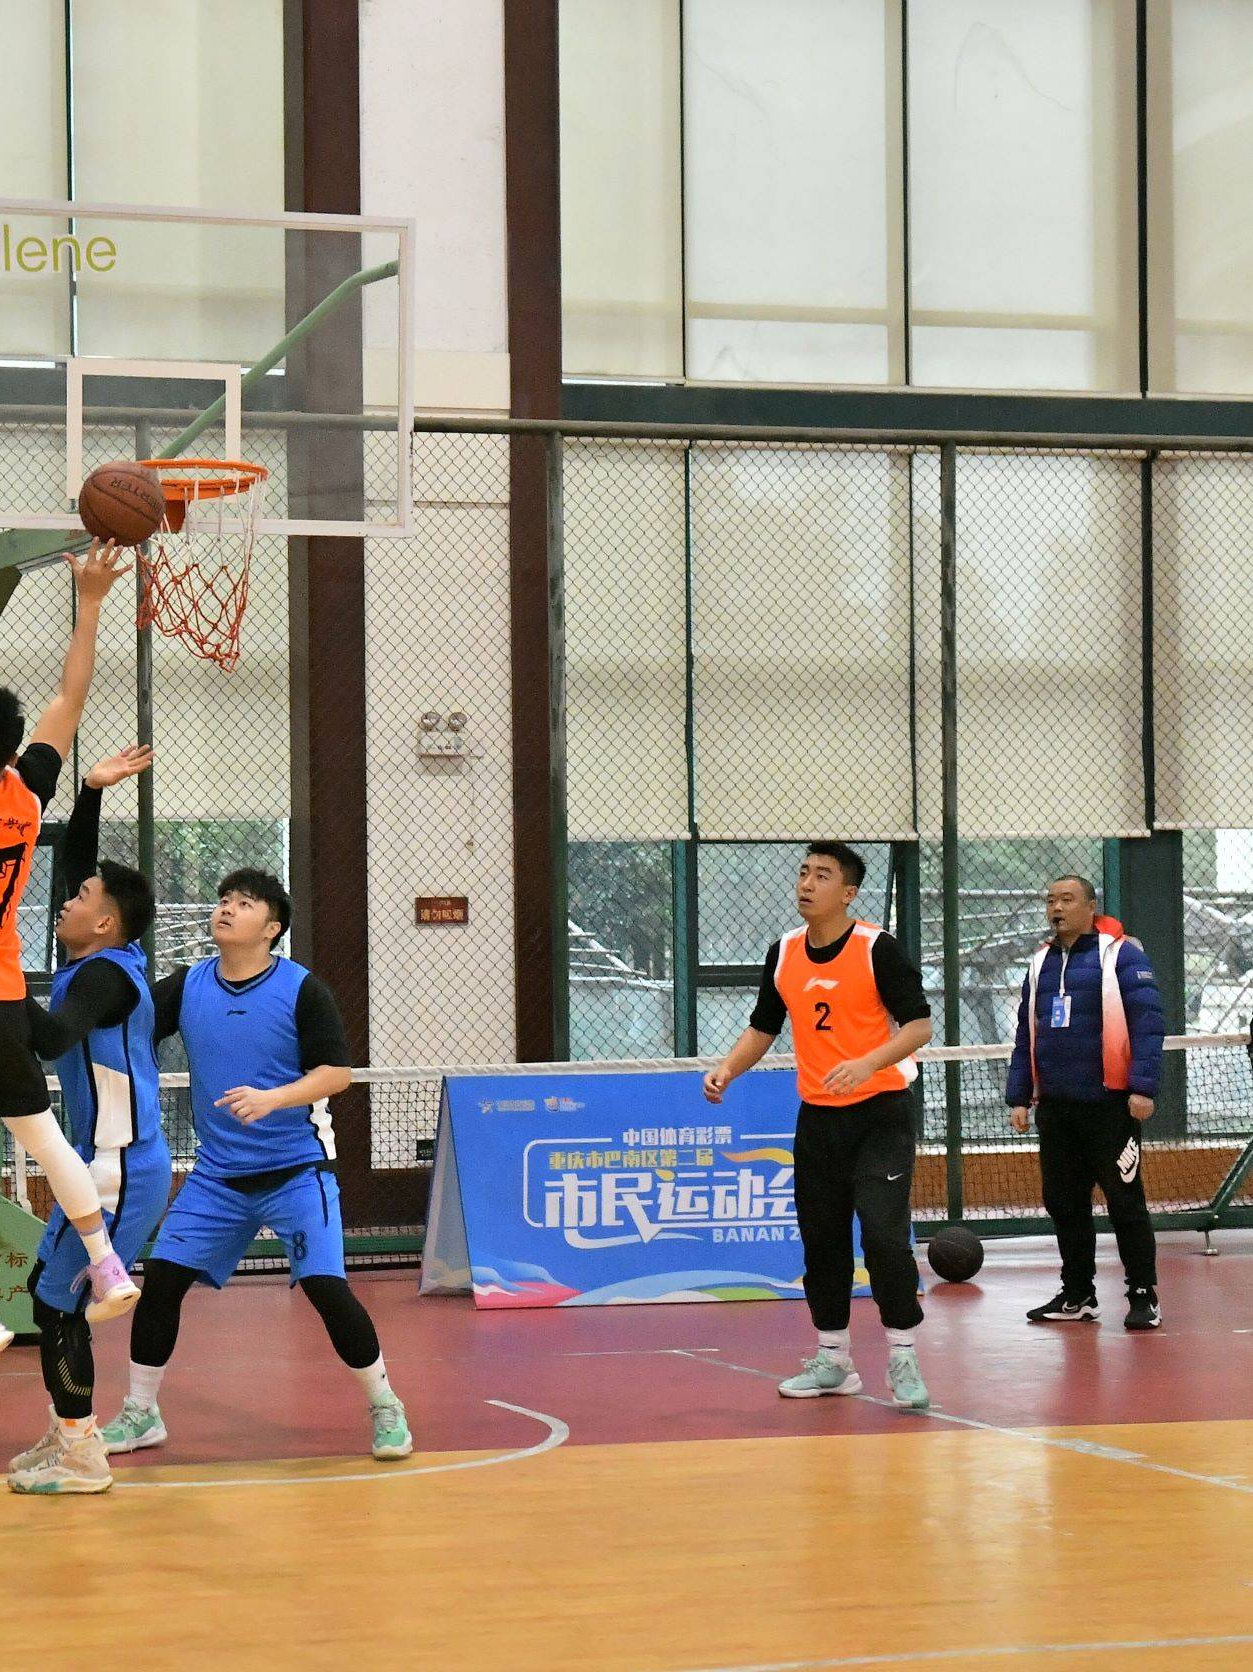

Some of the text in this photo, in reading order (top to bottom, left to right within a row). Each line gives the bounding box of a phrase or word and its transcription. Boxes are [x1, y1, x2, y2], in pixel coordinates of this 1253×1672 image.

[814, 1002, 832, 1031] 2
[622, 1127, 733, 1147] 中国体育彩票
[549, 1149, 714, 1170] 重庆市巴南区第二届
[1116, 1136, 1137, 1174] NIKE
[545, 1167, 798, 1243] 市民运动会
[293, 1231, 306, 1260] 8
[712, 1227, 785, 1242] BANAN
